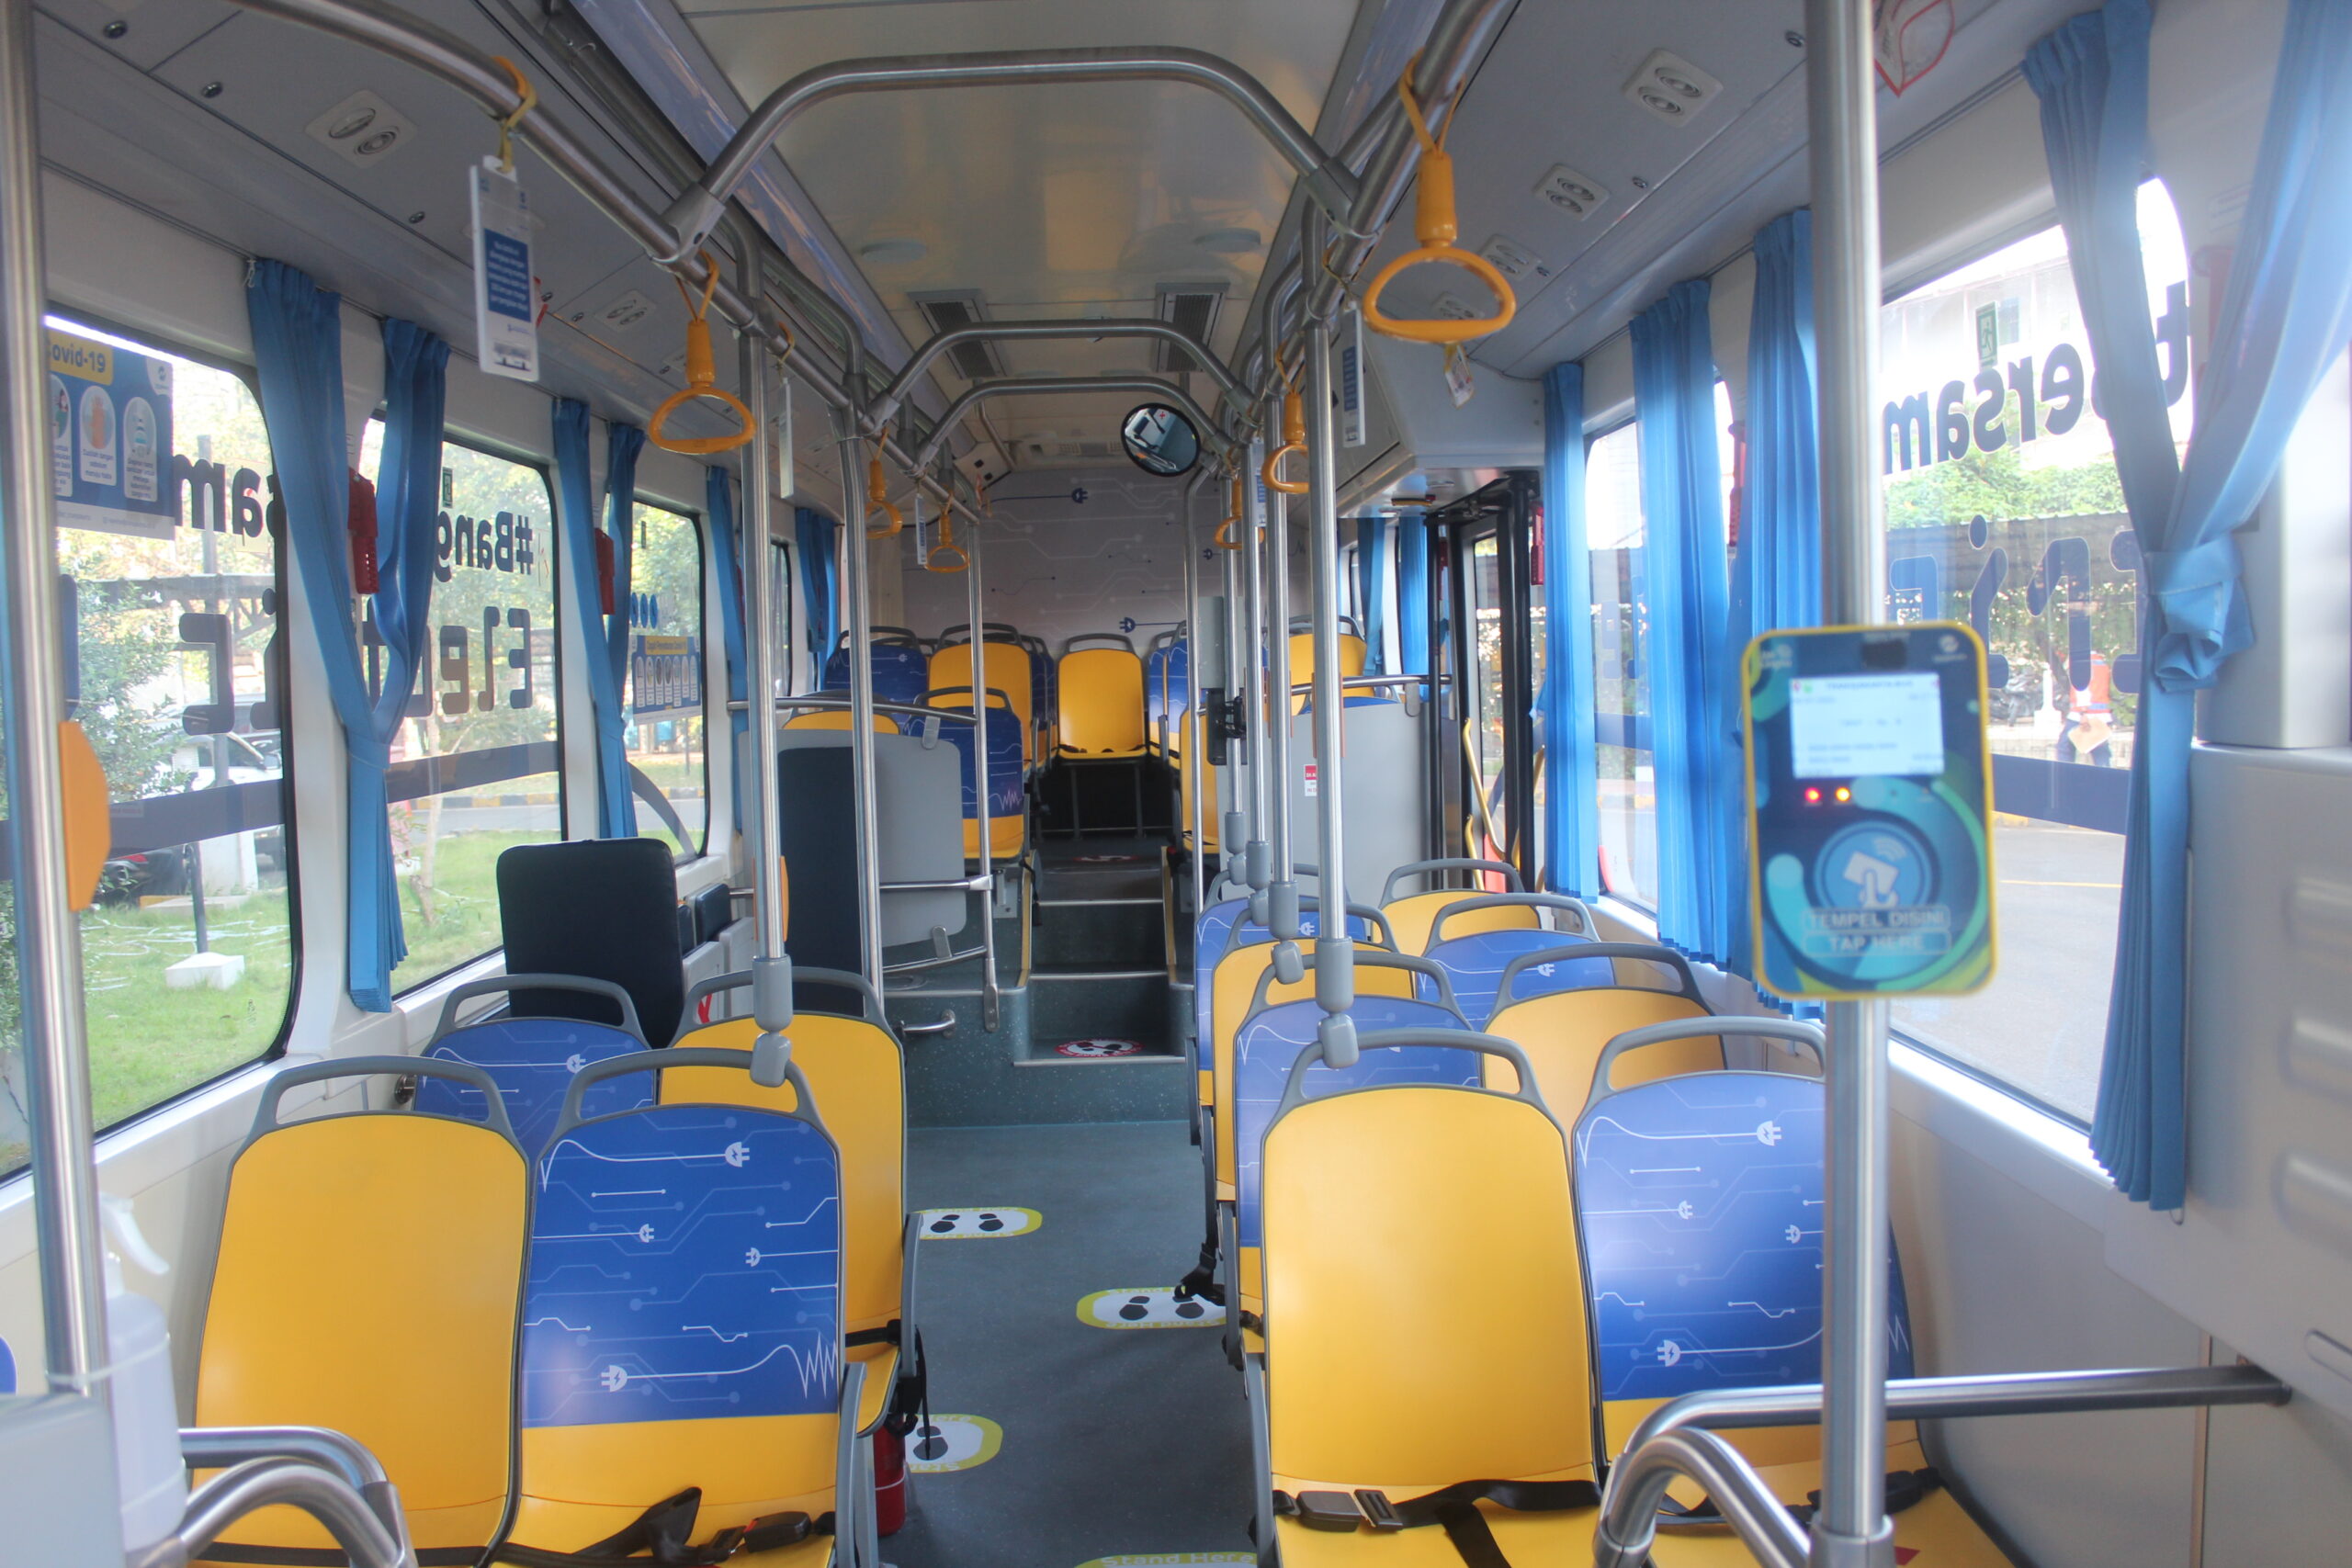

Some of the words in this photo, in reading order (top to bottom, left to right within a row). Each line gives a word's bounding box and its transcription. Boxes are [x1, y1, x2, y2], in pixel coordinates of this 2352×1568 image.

[49, 341, 106, 373] ovid-19
[1810, 912, 1883, 928] TEMPEL
[1828, 936, 1866, 952] TAP
[1875, 935, 1923, 950] HERE
[1100, 1552, 1181, 1567] Stand
[1190, 1551, 1255, 1564] Here
